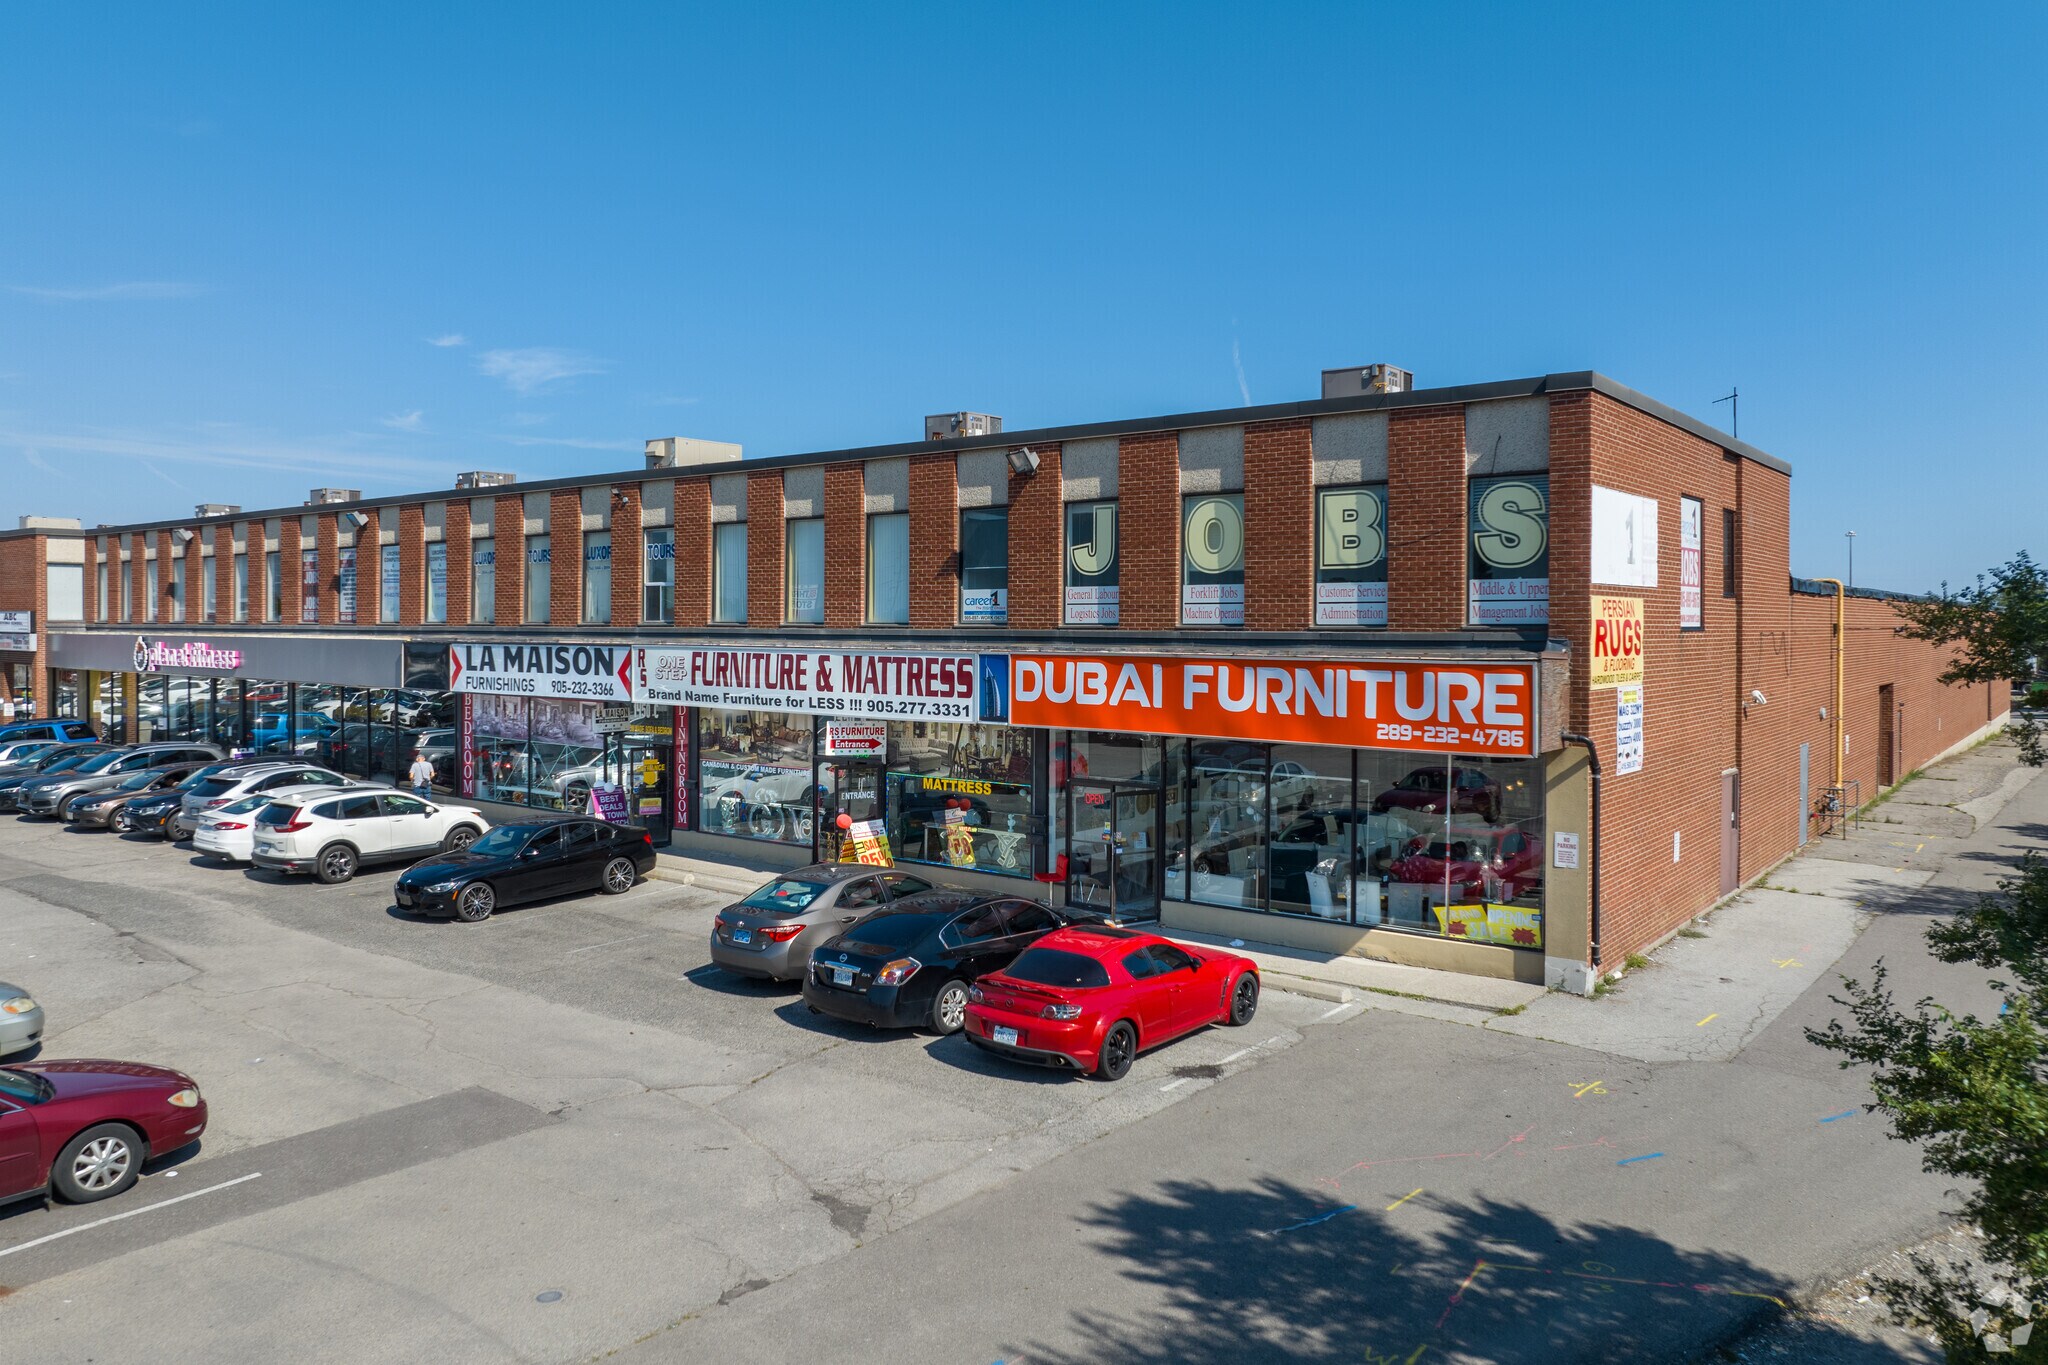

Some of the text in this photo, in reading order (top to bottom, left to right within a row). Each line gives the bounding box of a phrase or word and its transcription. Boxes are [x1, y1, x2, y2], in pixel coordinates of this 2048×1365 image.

[528, 549, 551, 563] TOURS
[647, 543, 675, 560] TOURS
[1068, 588, 1118, 600] General Labour
[1190, 586, 1238, 599] Forklift Jobs
[1319, 584, 1386, 598] Customer Service
[1472, 581, 1549, 598] Middle & Upper
[1070, 607, 1116, 621] Logistics Jobs
[1184, 607, 1244, 621] Machine Operator
[1321, 606, 1384, 619] Administration
[1472, 604, 1549, 621] Management Jobs
[1602, 599, 1636, 617] PERSIAN
[1595, 619, 1641, 657] RUGS
[466, 646, 614, 676] LA MAISON
[658, 655, 686, 669] ONE
[1604, 657, 1635, 672] & FLOORING
[655, 667, 688, 681] STEP
[691, 651, 973, 699] FURNITURE & MATTRESS
[466, 676, 535, 692] FURNISHINGS
[551, 681, 614, 696] 905-232-3366
[1015, 660, 1524, 726] DUBAI FURNITURE
[648, 689, 681, 701] Brand
[685, 691, 719, 703] Name
[723, 693, 782, 707] Furniture
[786, 696, 804, 708] for
[809, 697, 845, 710] LESS
[867, 700, 970, 717] 905.277.3331
[606, 707, 629, 717] MAISON
[830, 727, 885, 735] RS FURNITURE
[1376, 723, 1524, 747] 289-232-4786
[463, 694, 473, 793] BEDROOM
[836, 740, 870, 748] Entrance
[702, 761, 729, 769] CANADIAN
[736, 763, 760, 771] CUSTOM
[760, 765, 776, 774] MADE
[778, 767, 812, 776] FURNITURE
[923, 778, 992, 795] MATTRESS
[842, 791, 874, 800] ENTRANCE
[1085, 793, 1104, 804] OPEN
[600, 803, 623, 811] DEALS
[864, 838, 882, 850] SALE
